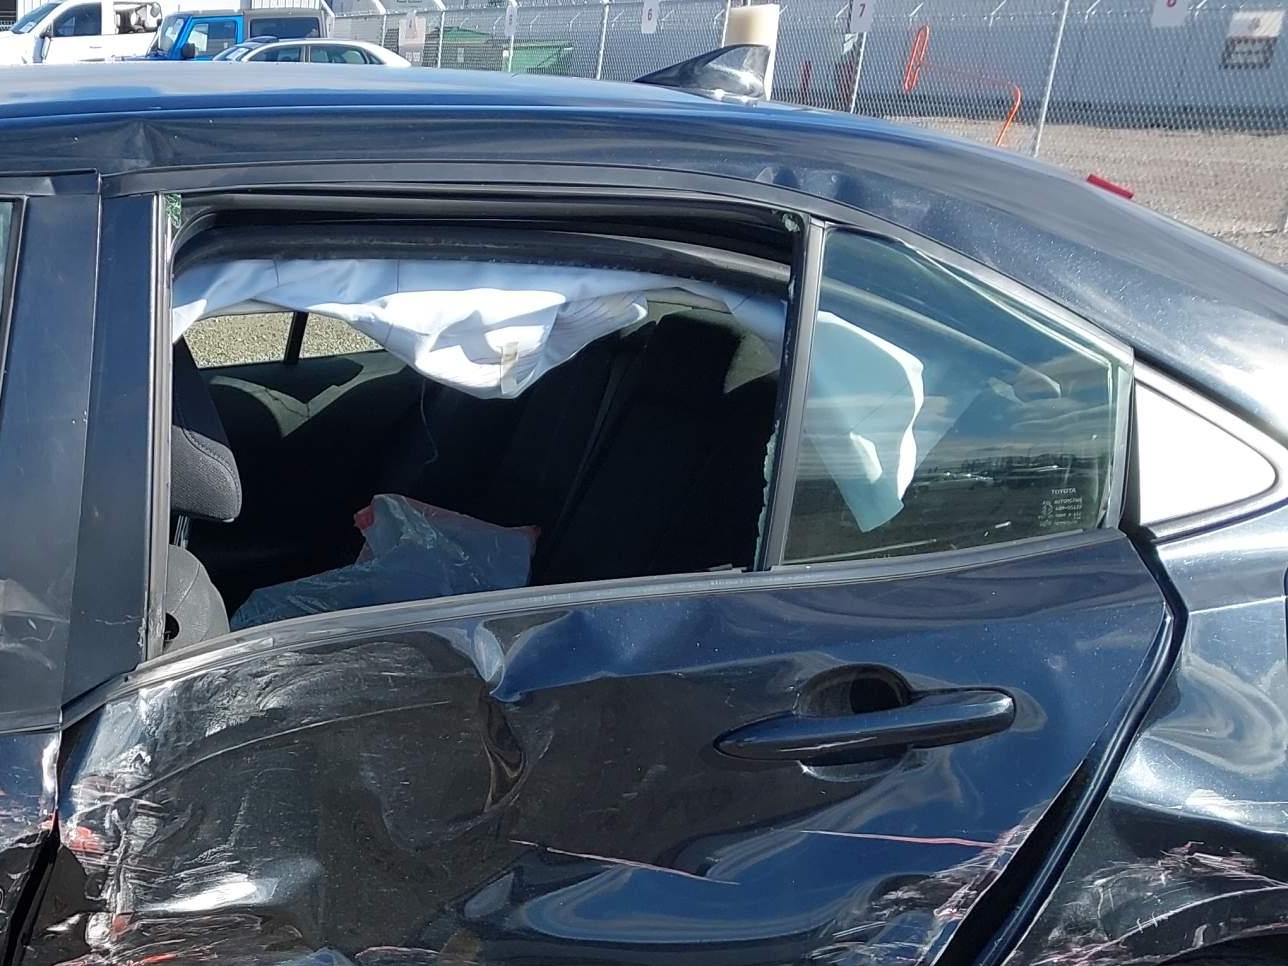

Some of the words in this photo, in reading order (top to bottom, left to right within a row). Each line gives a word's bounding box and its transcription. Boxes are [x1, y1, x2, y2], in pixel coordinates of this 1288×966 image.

[647, 8, 653, 21] 6
[859, 3, 866, 17] 7
[1051, 487, 1076, 495] TOYOTA
